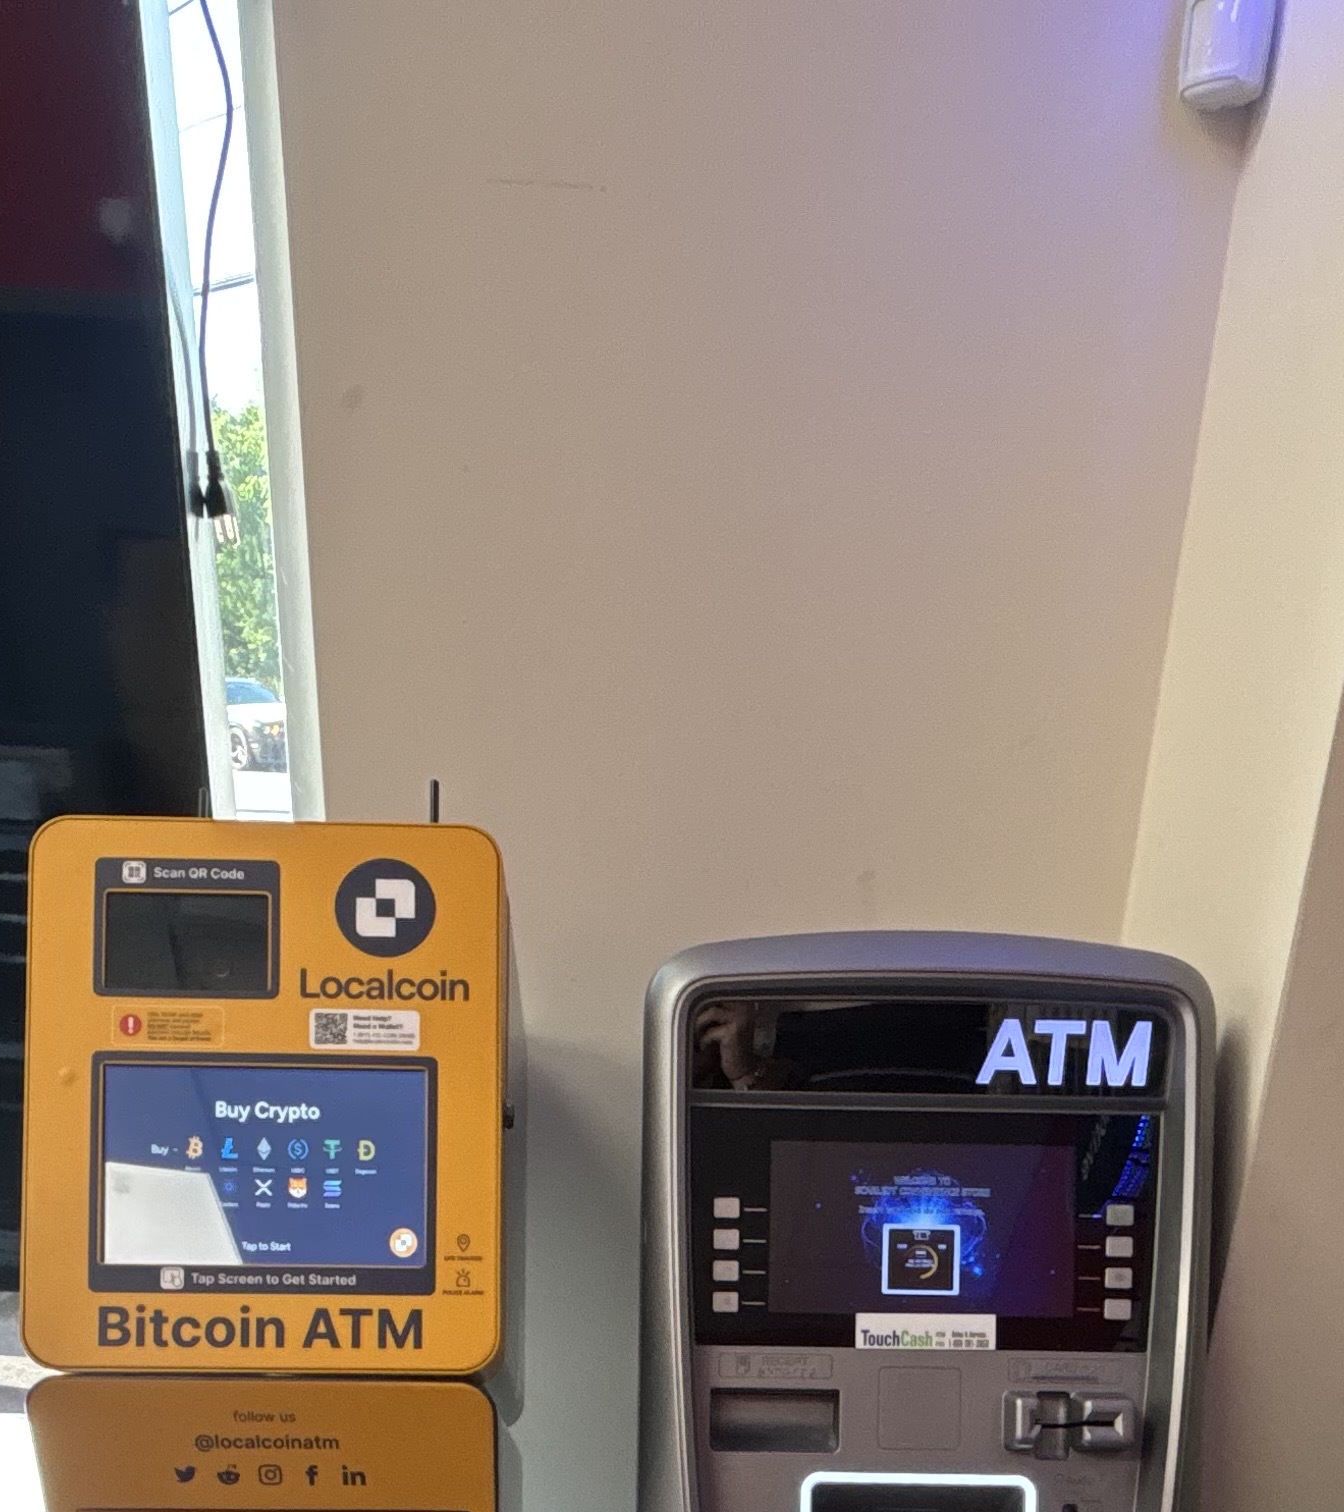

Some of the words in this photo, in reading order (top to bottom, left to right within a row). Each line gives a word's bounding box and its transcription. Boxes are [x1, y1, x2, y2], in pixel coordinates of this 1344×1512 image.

[154, 867, 185, 878] Scan
[189, 868, 207, 880] QR
[211, 868, 245, 880] Code
[299, 968, 470, 1002] Localcoin
[974, 1017, 1153, 1087] ATM
[214, 1100, 250, 1123] Buy
[254, 1101, 321, 1123] Crypto
[151, 1144, 169, 1156] Buy
[242, 1241, 258, 1253] Tap
[259, 1242, 269, 1251] to
[270, 1241, 291, 1252] Start
[191, 1273, 214, 1286] Tap
[218, 1273, 263, 1285] Screen
[266, 1275, 279, 1285] to
[282, 1274, 306, 1286] Get
[308, 1274, 357, 1286] Started
[97, 1303, 287, 1348] Bitcoin
[302, 1307, 424, 1350] ATM
[861, 1329, 933, 1347] TouchCash
[232, 1410, 275, 1423] follow
[279, 1411, 296, 1423] us
[194, 1434, 339, 1452] @localcoinatm
